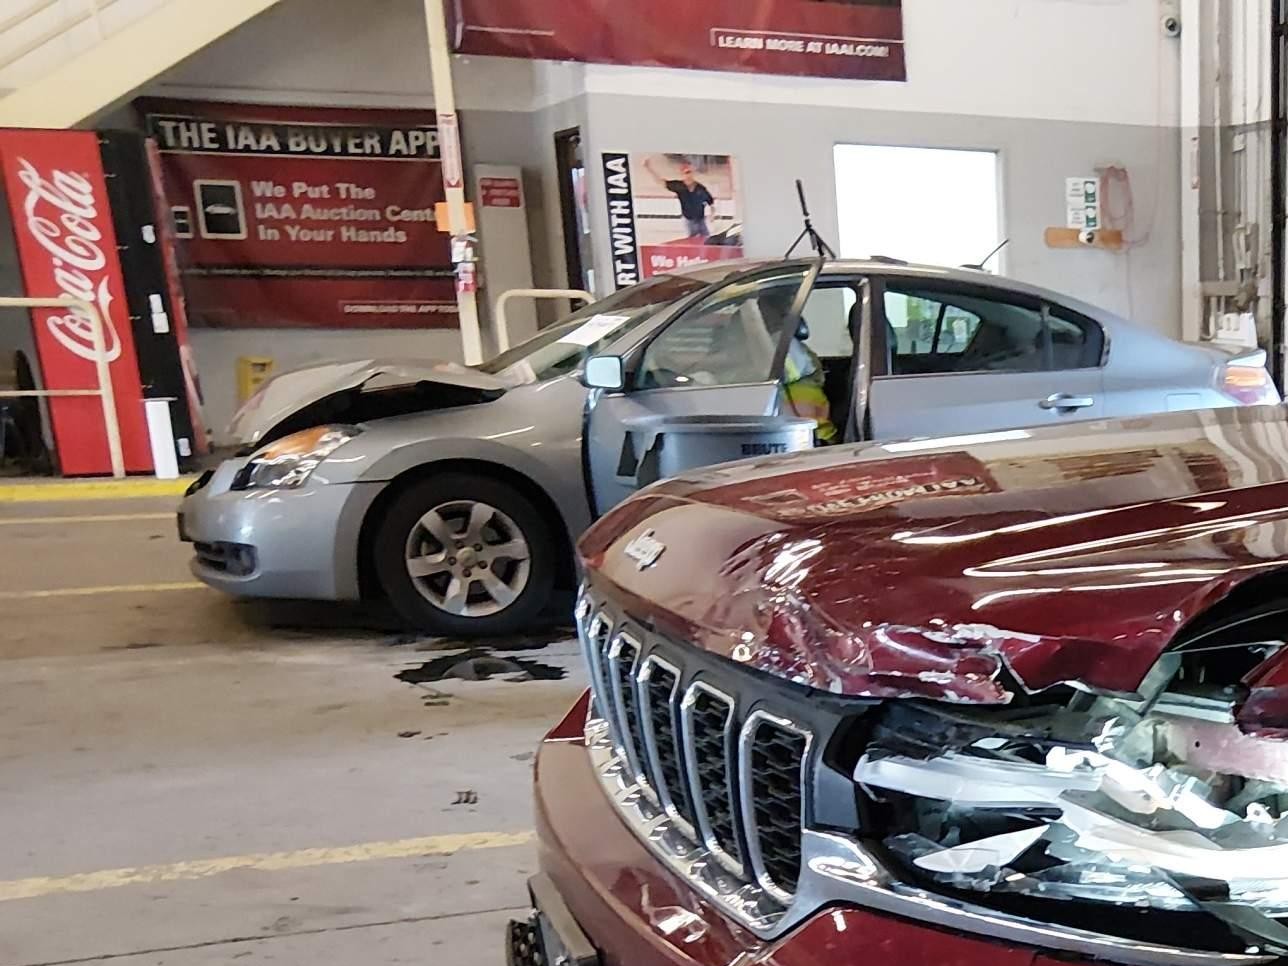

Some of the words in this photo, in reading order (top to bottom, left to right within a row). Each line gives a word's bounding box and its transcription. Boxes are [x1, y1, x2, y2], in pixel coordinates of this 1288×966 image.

[718, 36, 763, 49] LEARN
[765, 39, 804, 53] MORE
[805, 41, 824, 54] AT
[159, 120, 220, 149] THE
[225, 124, 281, 151] IAA
[287, 126, 382, 154] BUYER
[389, 130, 440, 155] APP
[606, 157, 629, 194] IAA
[251, 181, 286, 198] We
[292, 182, 330, 199] Put
[335, 183, 376, 200] The
[255, 203, 297, 220] IAA
[301, 204, 381, 221] Auction
[258, 224, 280, 241] In
[285, 225, 335, 242] Your
[340, 226, 407, 243] Hands
[609, 200, 634, 256] WITH
